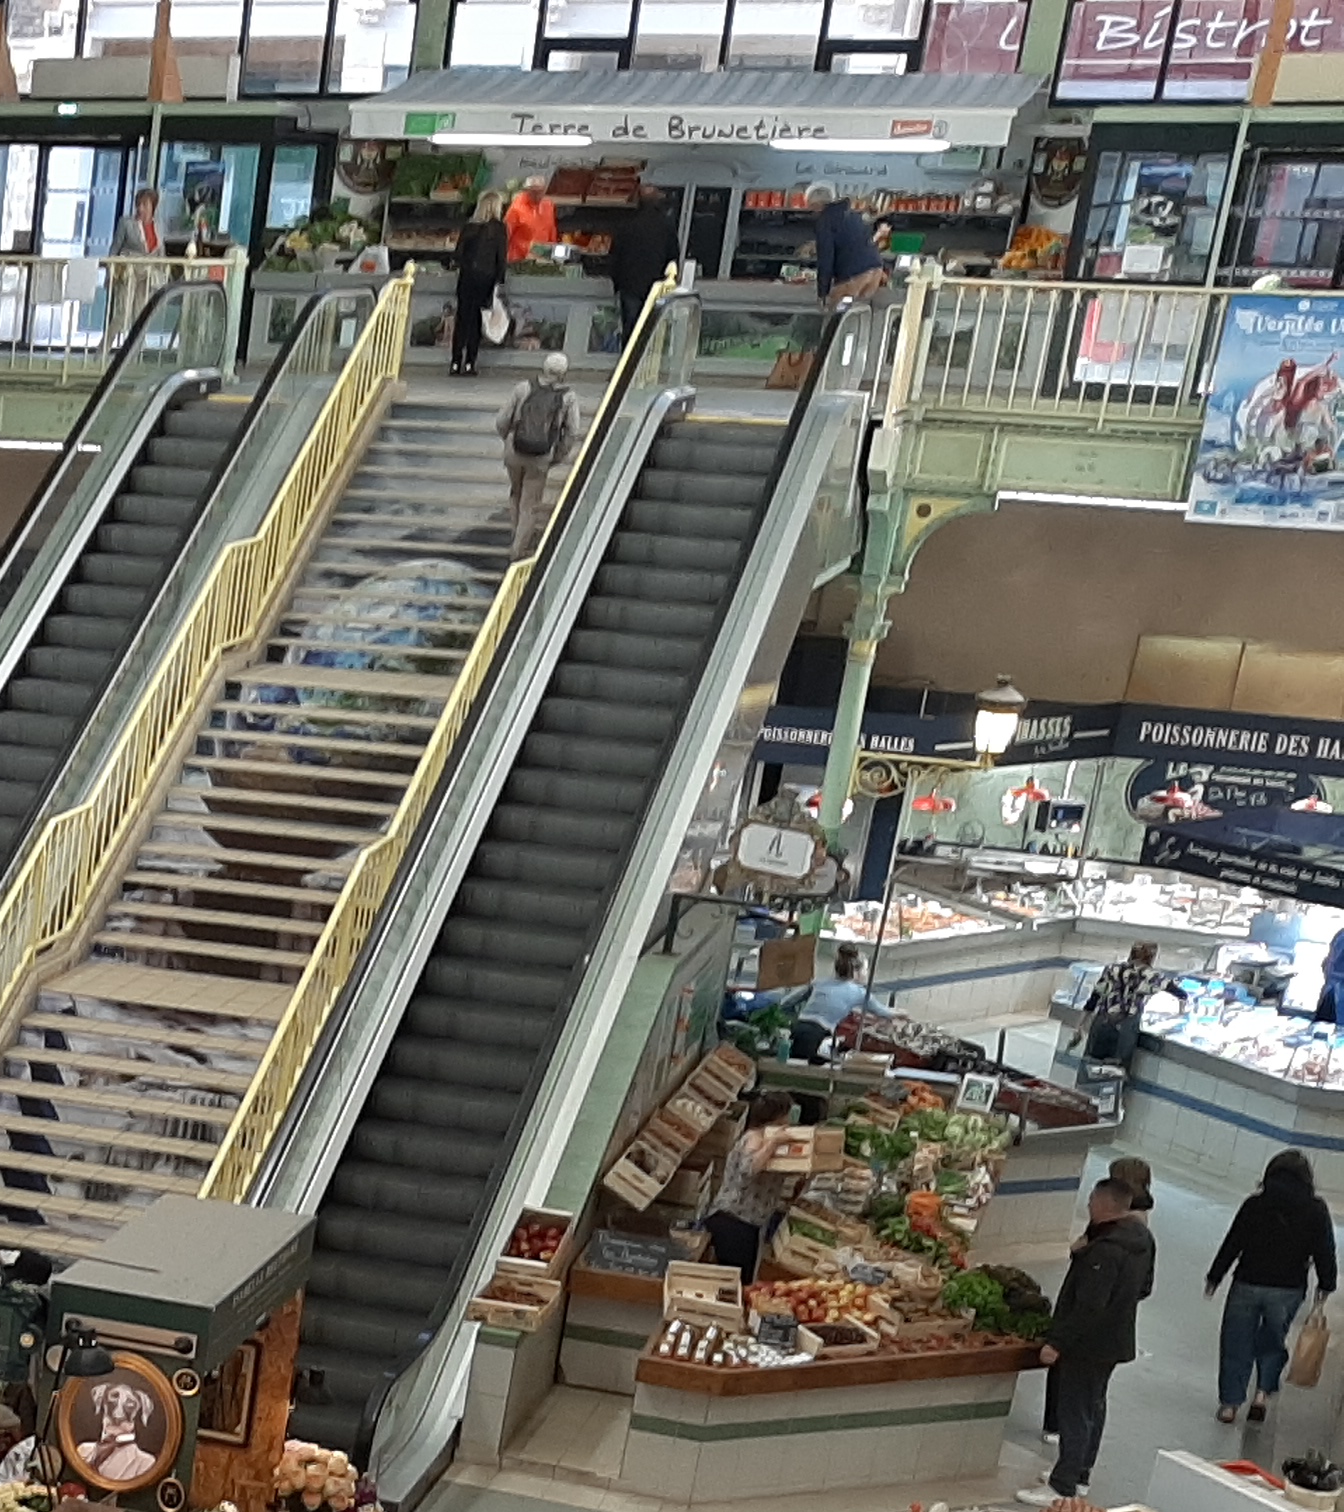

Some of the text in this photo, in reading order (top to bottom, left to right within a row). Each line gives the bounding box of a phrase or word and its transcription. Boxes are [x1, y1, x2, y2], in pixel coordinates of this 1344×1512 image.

[512, 112, 591, 137] Terre
[612, 115, 648, 139] de
[1139, 720, 1270, 754] POISSONNERIE
[1273, 732, 1311, 757] DES
